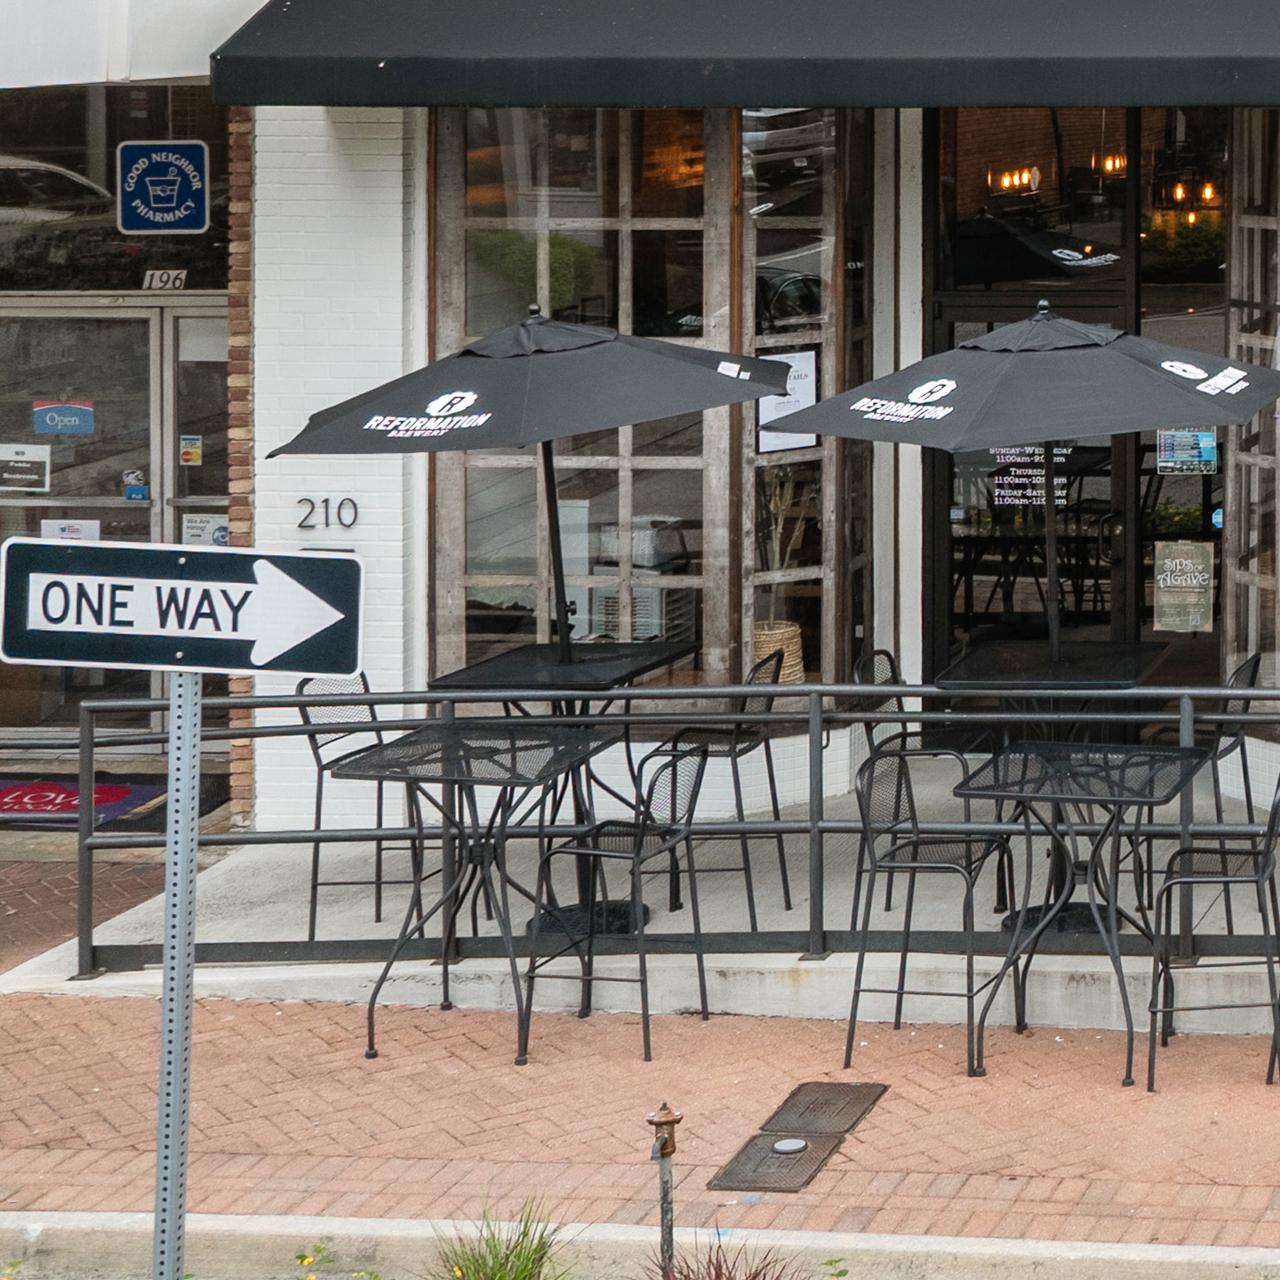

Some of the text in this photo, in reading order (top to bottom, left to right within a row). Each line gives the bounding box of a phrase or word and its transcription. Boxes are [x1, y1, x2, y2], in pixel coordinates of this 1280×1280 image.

[125, 152, 202, 192] GOOD NEIGHBOR
[131, 198, 196, 223] PHARMACY
[148, 271, 184, 290] 196
[850, 397, 954, 420] REFORMATION
[45, 413, 79, 430] Open
[363, 413, 492, 431] REFORMATION
[387, 429, 449, 438] BREWERY
[297, 498, 358, 528] 210
[42, 580, 253, 633] ONE WAY
